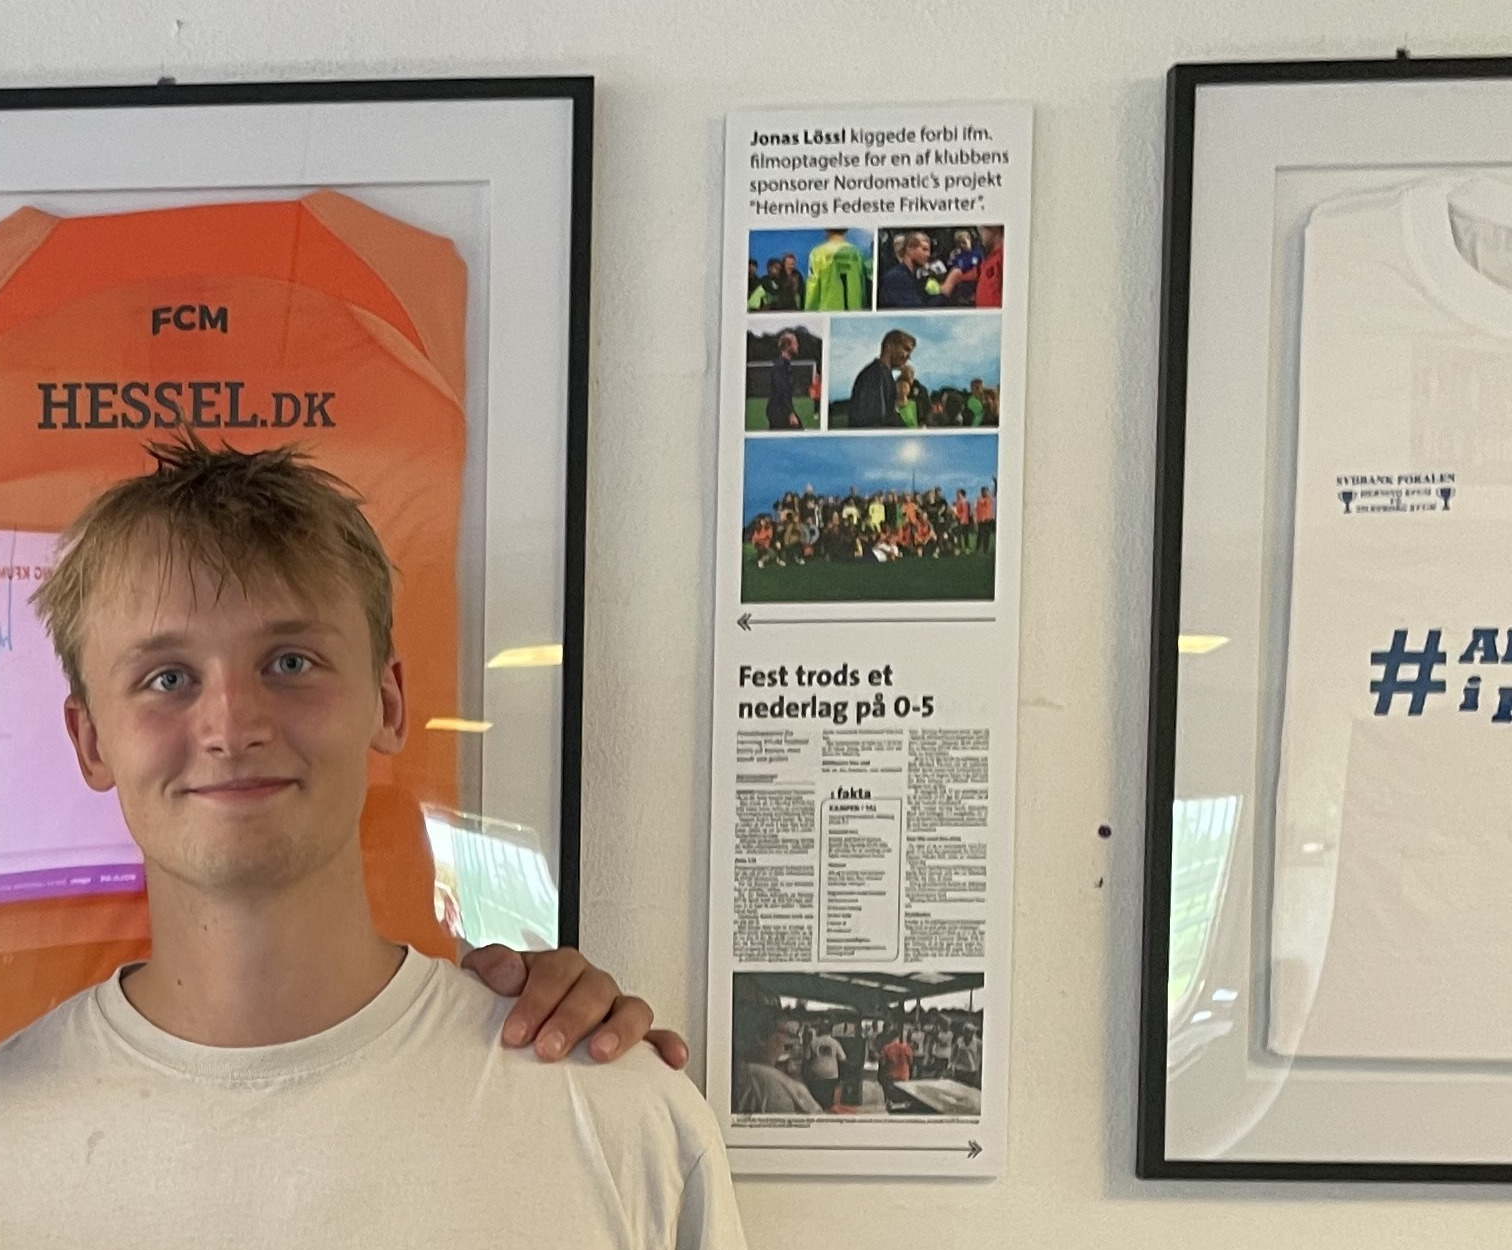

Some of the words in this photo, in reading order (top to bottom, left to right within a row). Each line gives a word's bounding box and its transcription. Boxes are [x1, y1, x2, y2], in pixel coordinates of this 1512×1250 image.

[750, 131, 799, 146] Jonas
[804, 127, 845, 144] Lössl
[850, 126, 915, 147] kiggede
[920, 125, 958, 141] forbi
[750, 151, 860, 170] filmoptagelse
[864, 149, 887, 166] for
[890, 153, 911, 166] en
[915, 149, 932, 165] af
[934, 149, 1009, 165] klubbens
[749, 178, 830, 194] sponsorer
[834, 174, 940, 190] Nordomatic's
[945, 172, 1003, 191] projekt
[833, 196, 895, 213] Fedeste
[151, 304, 229, 336] FCM
[37, 381, 336, 430] HESSEL.DK
[739, 665, 788, 687] Fest
[796, 663, 861, 687] trods
[868, 664, 893, 686] et
[738, 695, 848, 725] nederlag
[856, 692, 886, 725] på
[894, 695, 934, 718] 0-5
